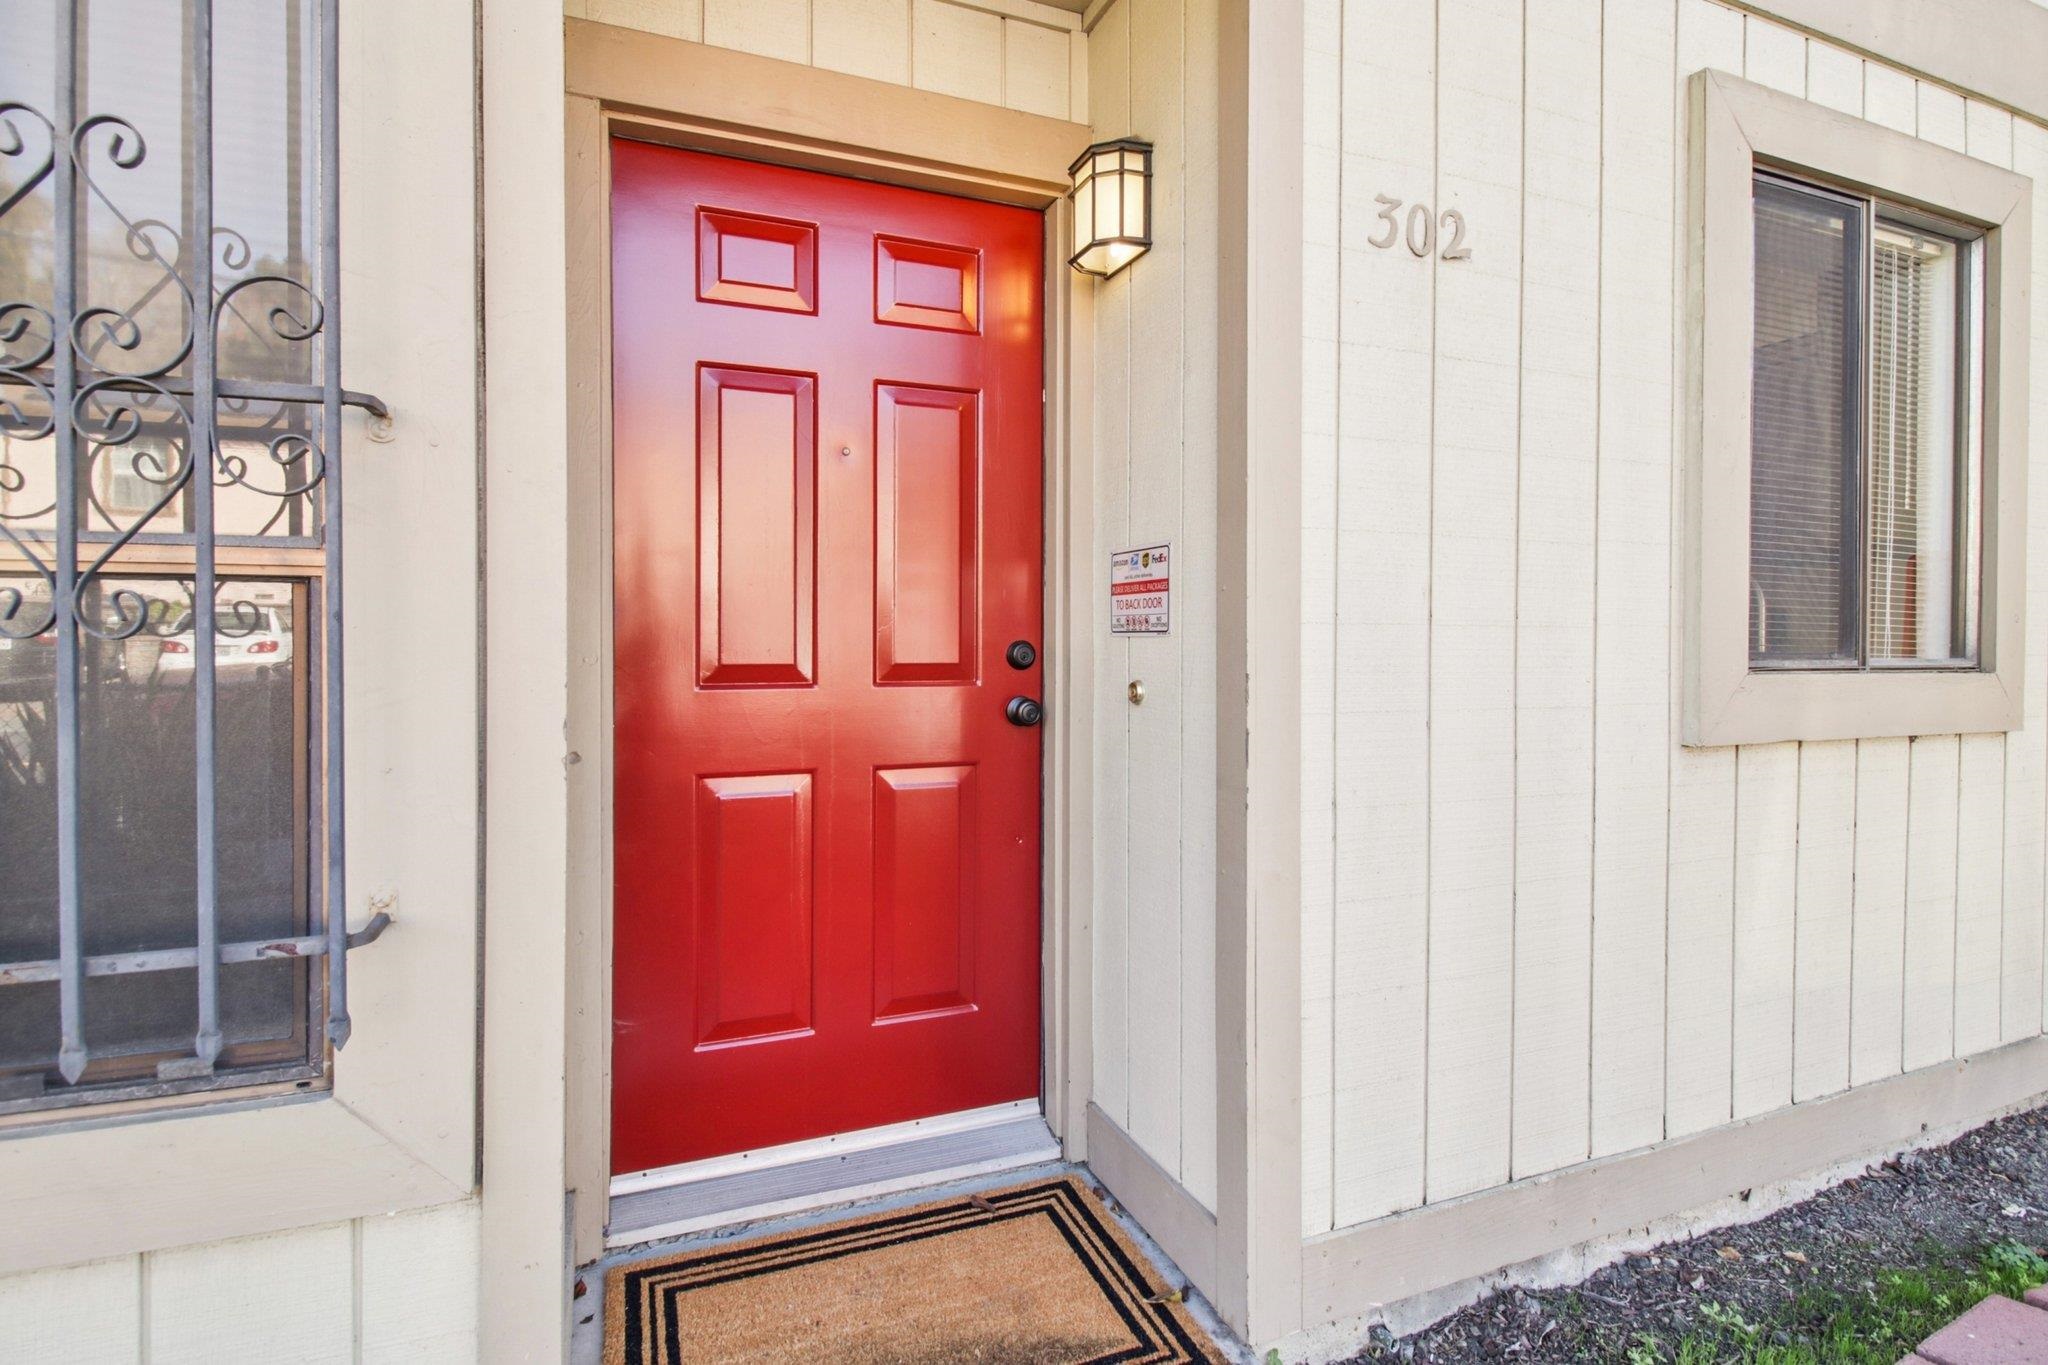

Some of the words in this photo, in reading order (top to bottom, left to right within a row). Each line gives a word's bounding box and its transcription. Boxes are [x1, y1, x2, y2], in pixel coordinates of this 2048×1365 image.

[1367, 193, 1473, 260] 302
[1152, 553, 1167, 563] FedEx
[1124, 584, 1139, 593] DELIVER
[1147, 581, 1168, 591] PACKAGES
[1116, 599, 1124, 610] TO
[1125, 598, 1141, 610] BACK
[1142, 596, 1163, 609] DOOR
